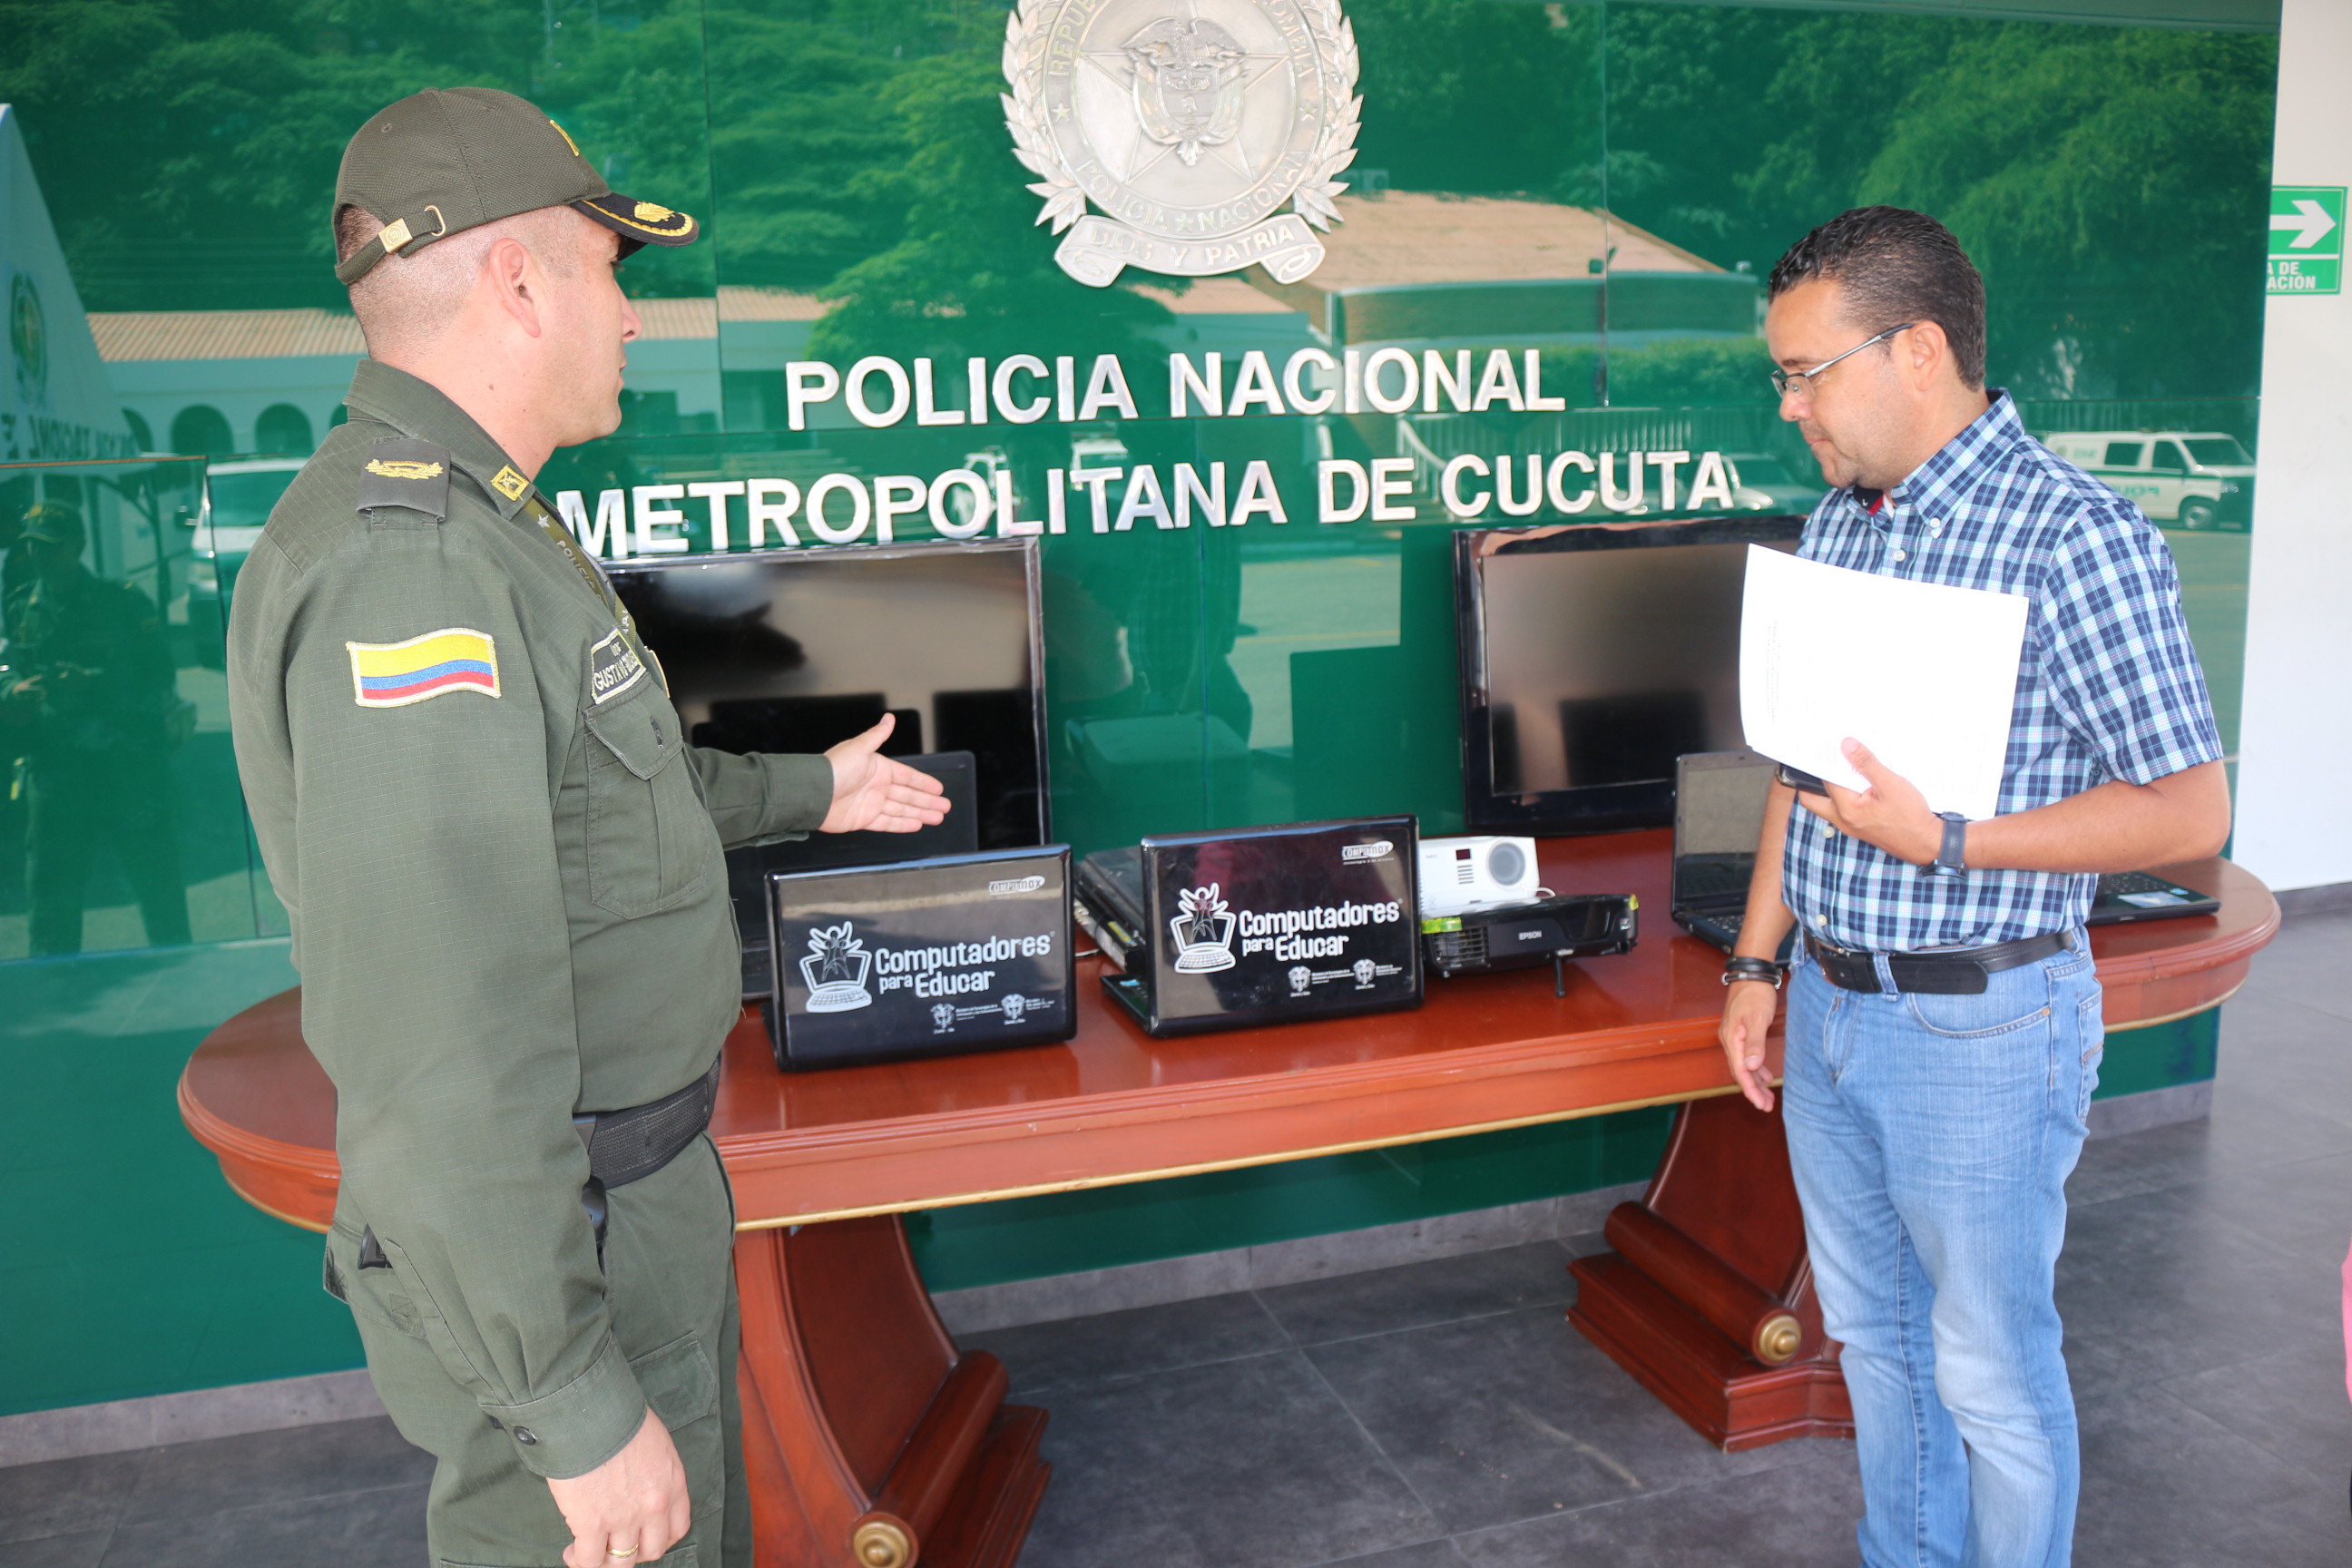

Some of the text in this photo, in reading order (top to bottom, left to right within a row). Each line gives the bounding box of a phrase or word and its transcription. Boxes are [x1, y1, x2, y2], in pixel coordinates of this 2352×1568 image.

[1075, 150, 1308, 232] POLICIA NACIONAL
[1090, 224, 1296, 268] DIOS Y PATRIA
[2278, 260, 2300, 276] DE
[786, 346, 1567, 431] POLICIA NACIONAL
[555, 450, 1735, 559] METROPOLITANA DE CUCUTA
[1239, 899, 1400, 939] Computadores
[1518, 930, 1543, 941] EPSON
[875, 935, 1052, 975] Computadores
[1242, 934, 1350, 962] para Educar
[878, 970, 996, 999] para Educar
